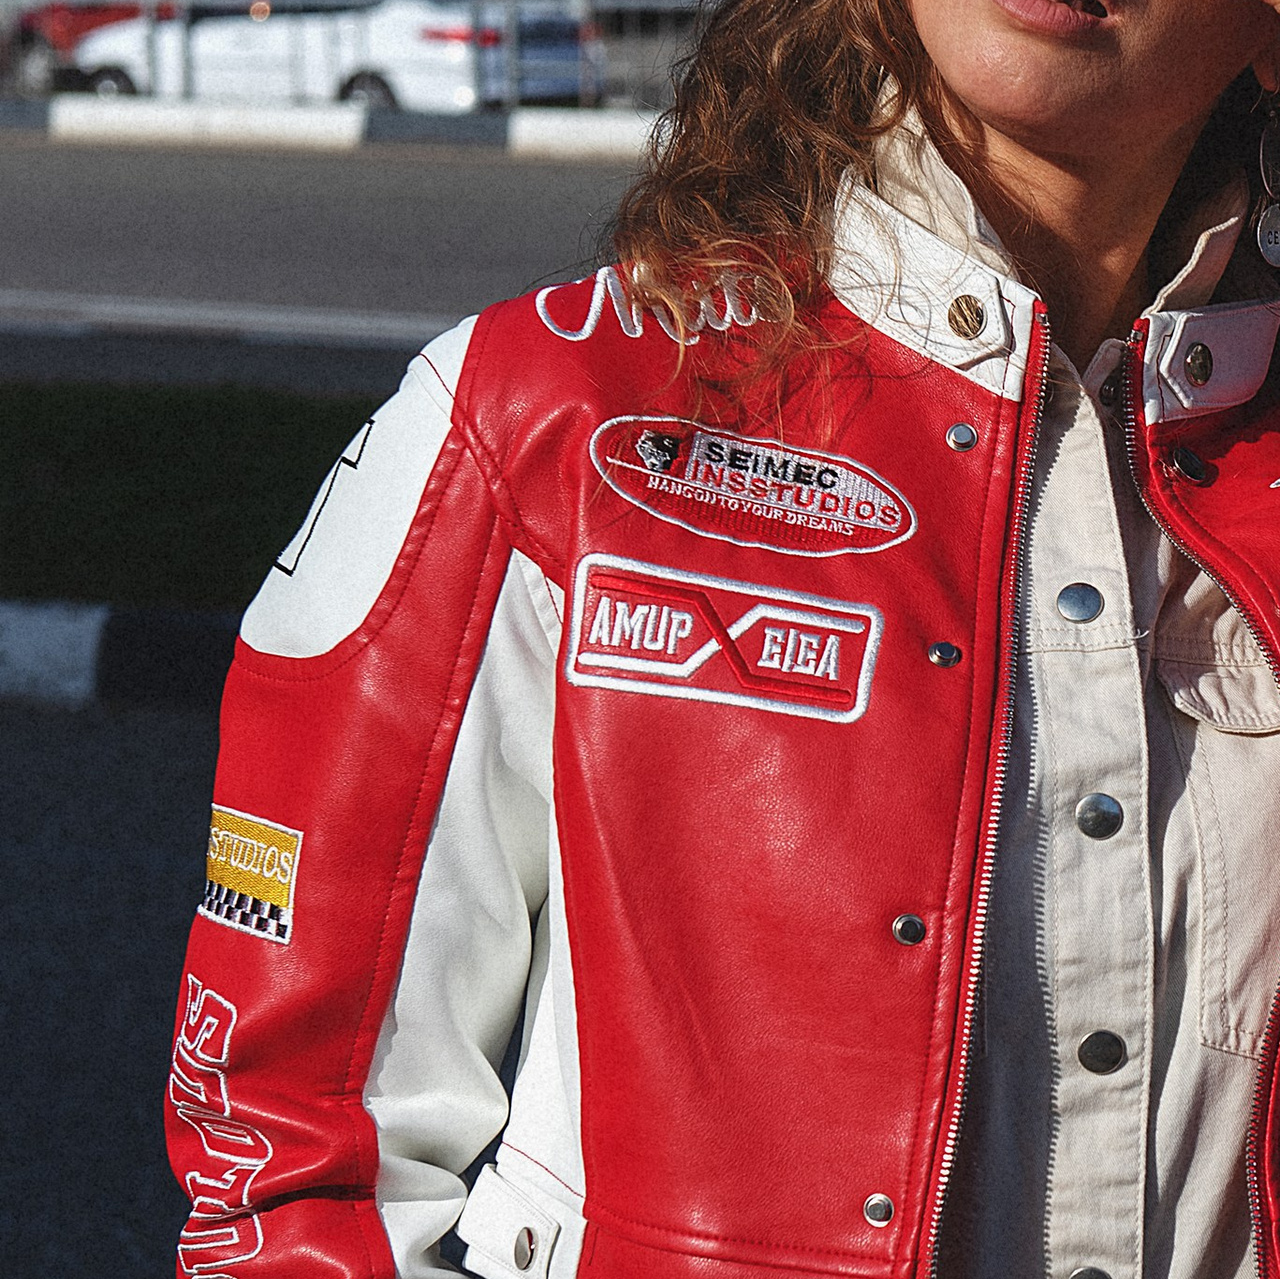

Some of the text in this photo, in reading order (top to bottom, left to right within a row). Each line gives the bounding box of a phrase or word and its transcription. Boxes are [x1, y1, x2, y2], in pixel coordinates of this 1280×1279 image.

[784, 510, 855, 538] DREAMS
[588, 596, 694, 655] AMUP
[206, 826, 293, 884] STUDIOS
